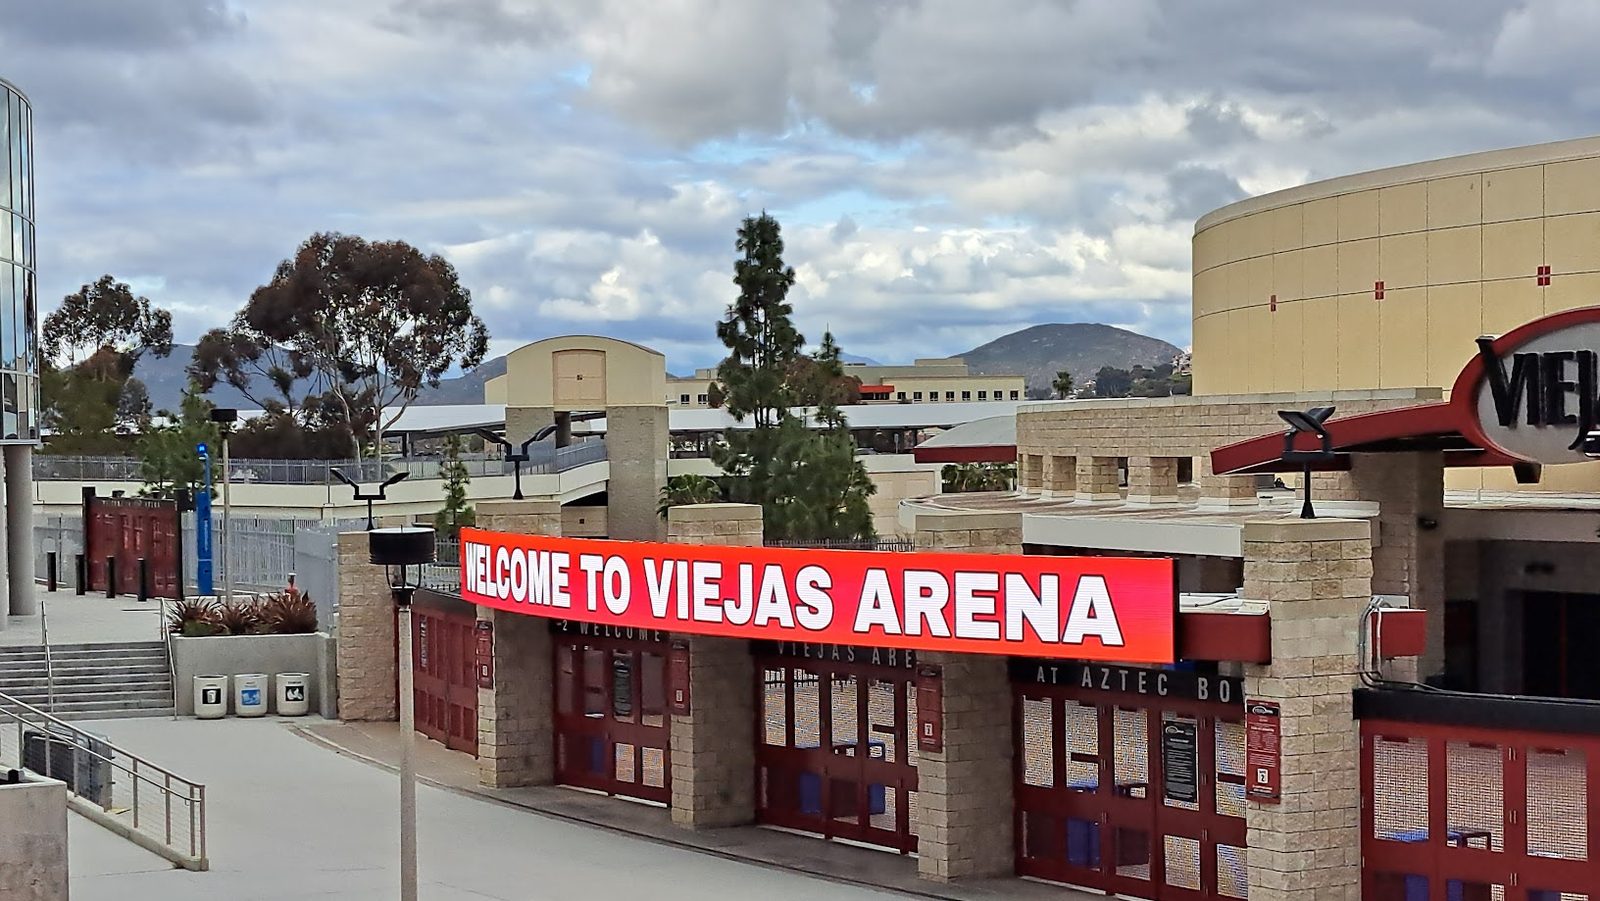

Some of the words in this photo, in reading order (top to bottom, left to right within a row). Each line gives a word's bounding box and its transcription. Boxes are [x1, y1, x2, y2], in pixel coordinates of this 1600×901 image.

[1475, 335, 1600, 451] VIEJ
[465, 541, 571, 609] WELCOME
[579, 554, 632, 615] TO
[643, 558, 834, 631] VIEJAS
[853, 568, 1125, 647] ARENA
[580, 621, 661, 642] WELCOME
[777, 640, 855, 663] VIEJAS
[872, 648, 913, 669] ARE
[1037, 665, 1058, 684] AT
[1081, 666, 1168, 696] AZTEC
[1198, 677, 1245, 703] BO
